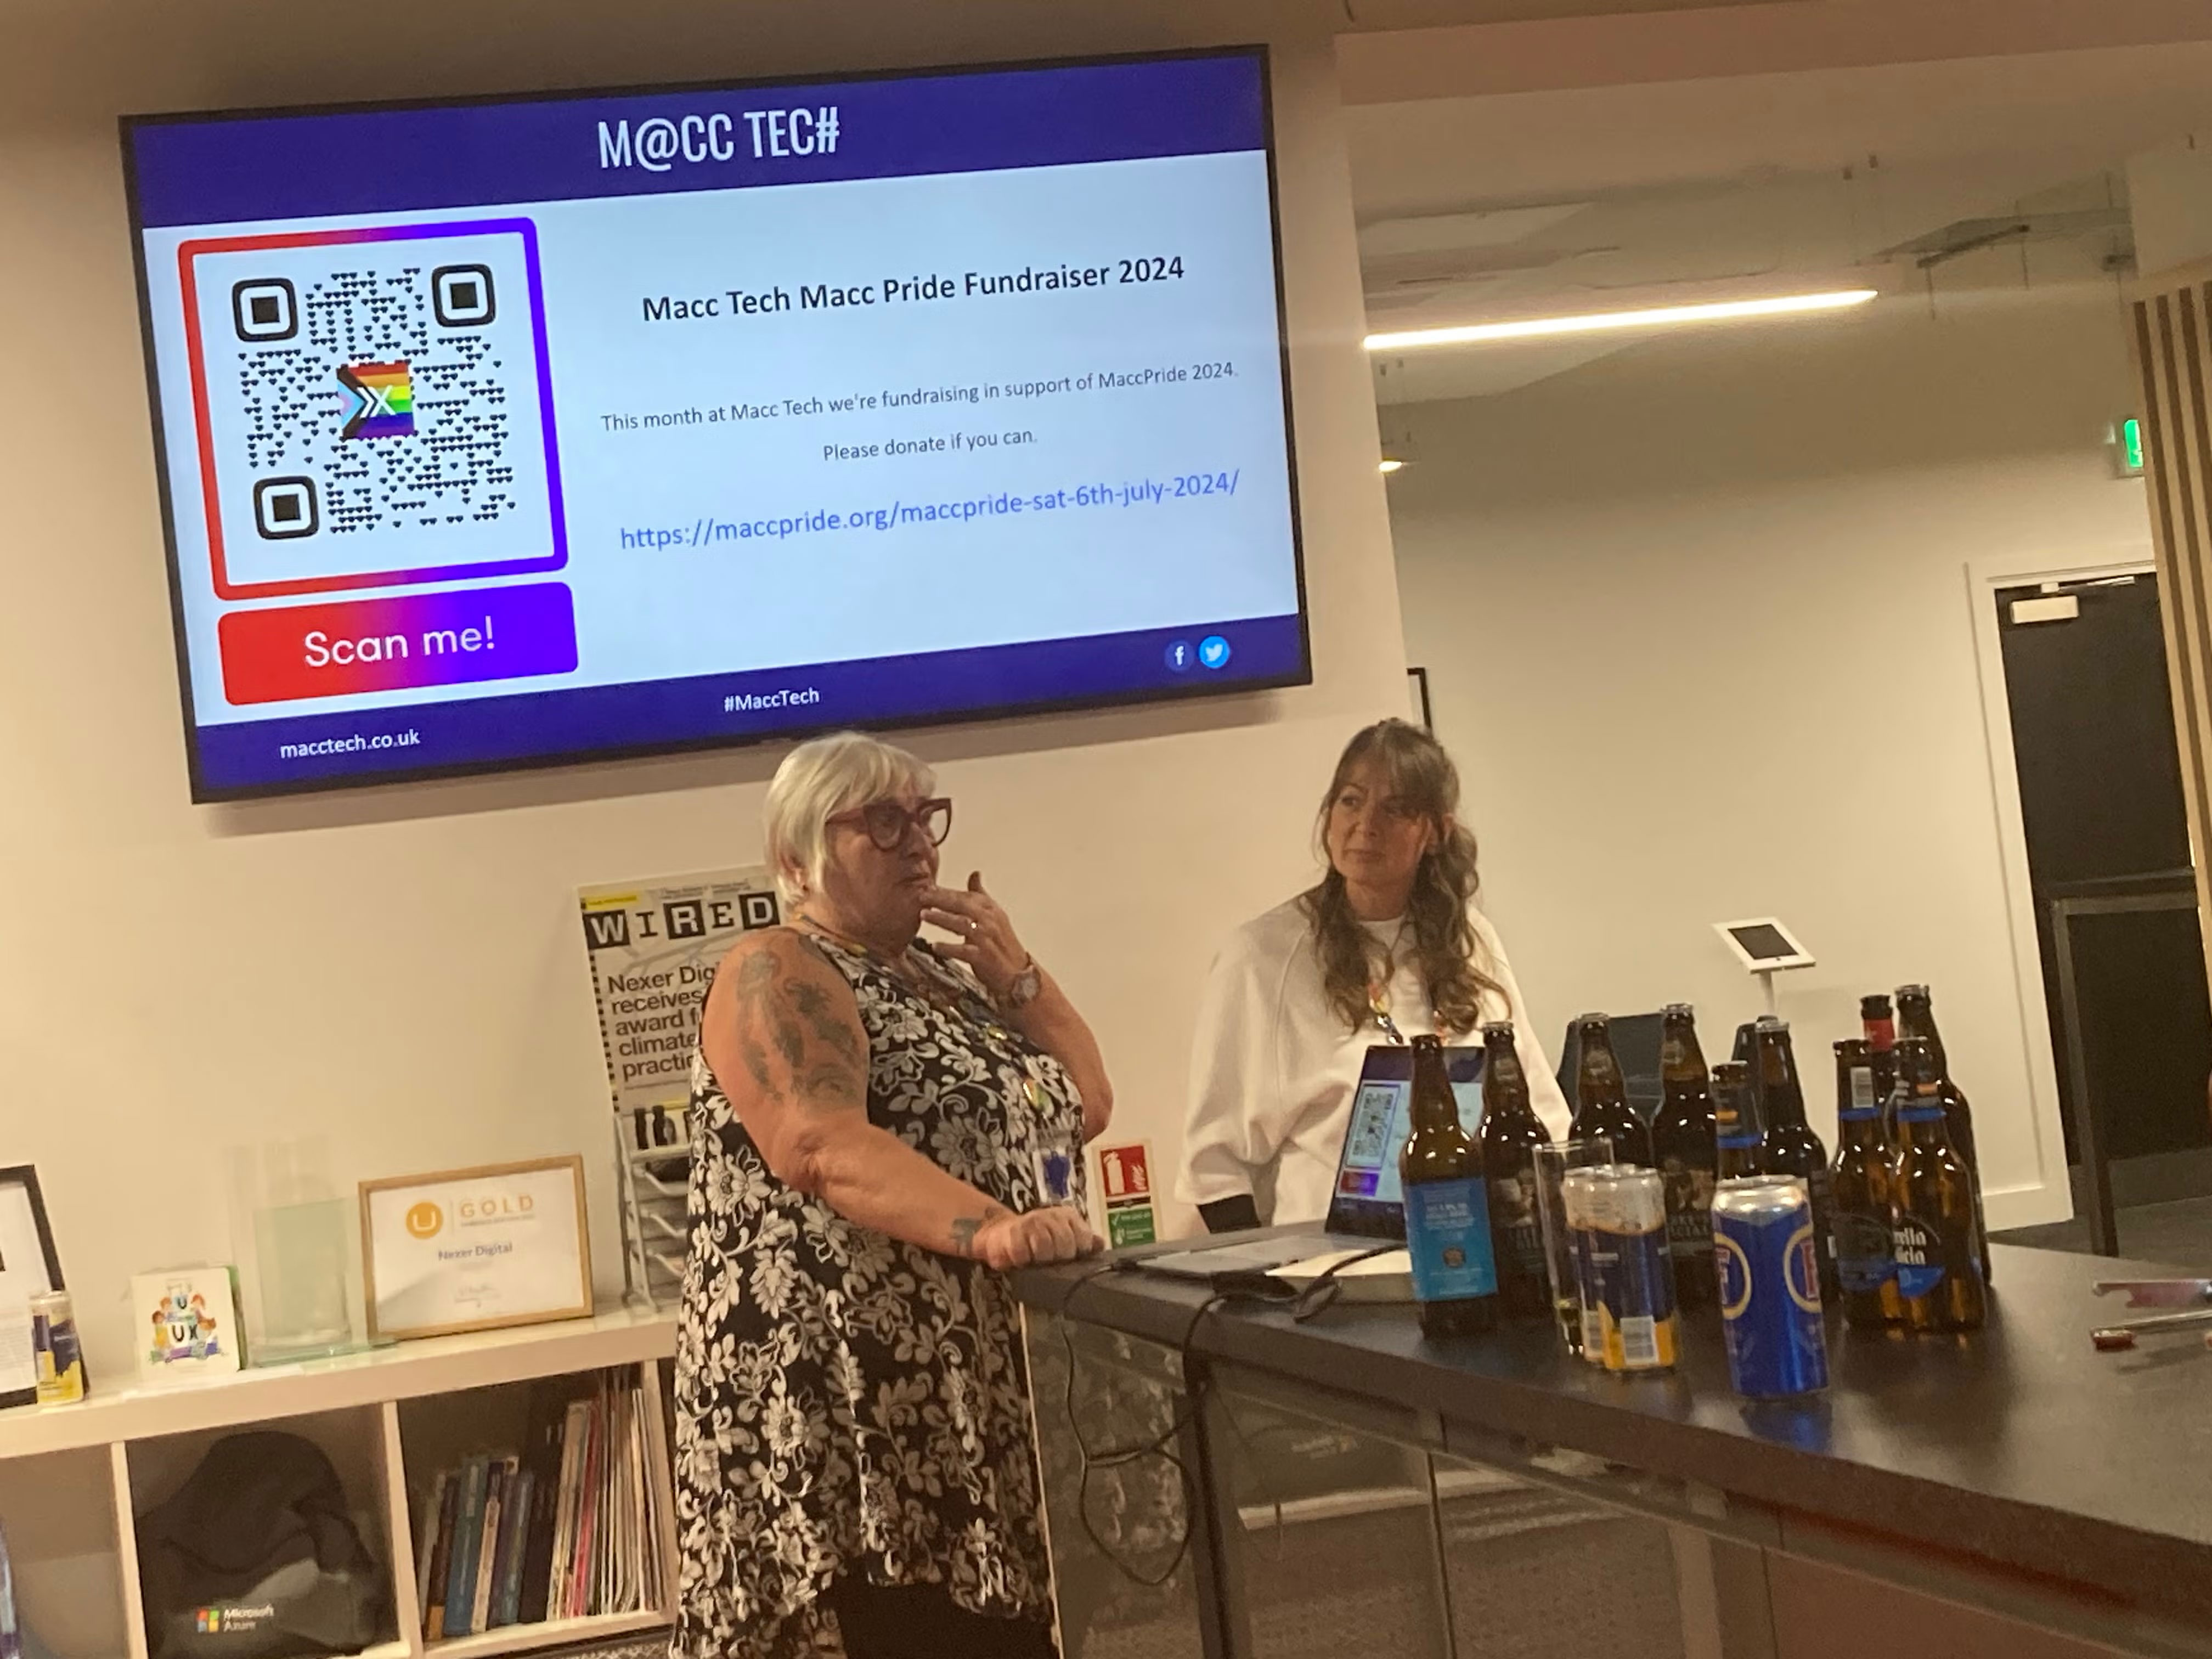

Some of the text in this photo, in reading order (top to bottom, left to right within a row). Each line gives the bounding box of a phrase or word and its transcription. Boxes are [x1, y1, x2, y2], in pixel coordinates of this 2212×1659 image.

[598, 106, 839, 171] M@CC TEC#
[642, 256, 1184, 321] Macc Tech Macc Pride Fundraiser 2024
[601, 362, 1239, 432] This month at Macc Tech we're fundraising in support of MaccPride 2024.
[823, 429, 1037, 461] Please donate if you can.
[620, 469, 1239, 551] https://maccpride.org/maccpride-sat-6th-july-2024/
[304, 615, 494, 667] Scan me!
[724, 686, 820, 712] #MaccTech
[280, 729, 421, 759] macctech.co.uk
[585, 893, 778, 947] WIRED
[607, 972, 674, 994] Nexer
[611, 990, 703, 1015] receives
[616, 1009, 684, 1036] award
[619, 1031, 697, 1056] climate
[460, 1194, 534, 1218] GOLD
[438, 1242, 513, 1261] Nexer Digital
